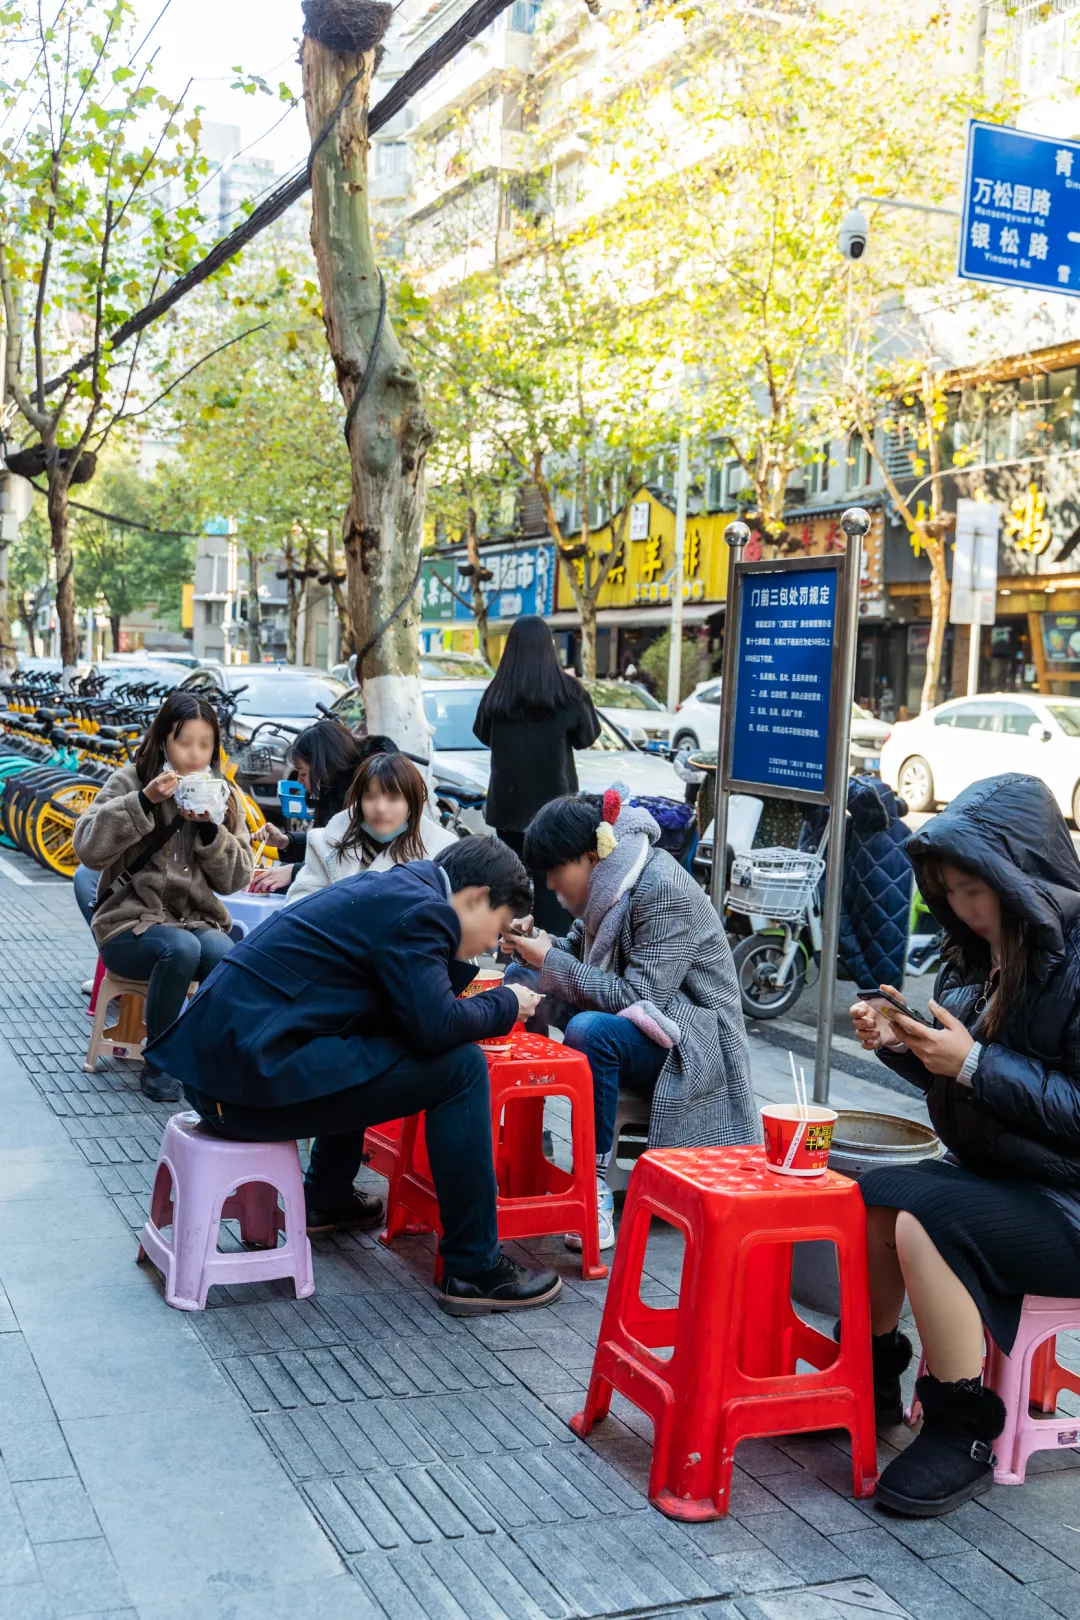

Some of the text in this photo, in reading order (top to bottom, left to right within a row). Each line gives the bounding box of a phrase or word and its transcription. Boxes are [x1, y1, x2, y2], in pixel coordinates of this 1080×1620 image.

[973, 177, 1052, 217] 万松园路
[971, 221, 1049, 261] 银松路
[456, 552, 535, 593] 万园超市
[751, 585, 830, 608] 门前三包处罚规定
